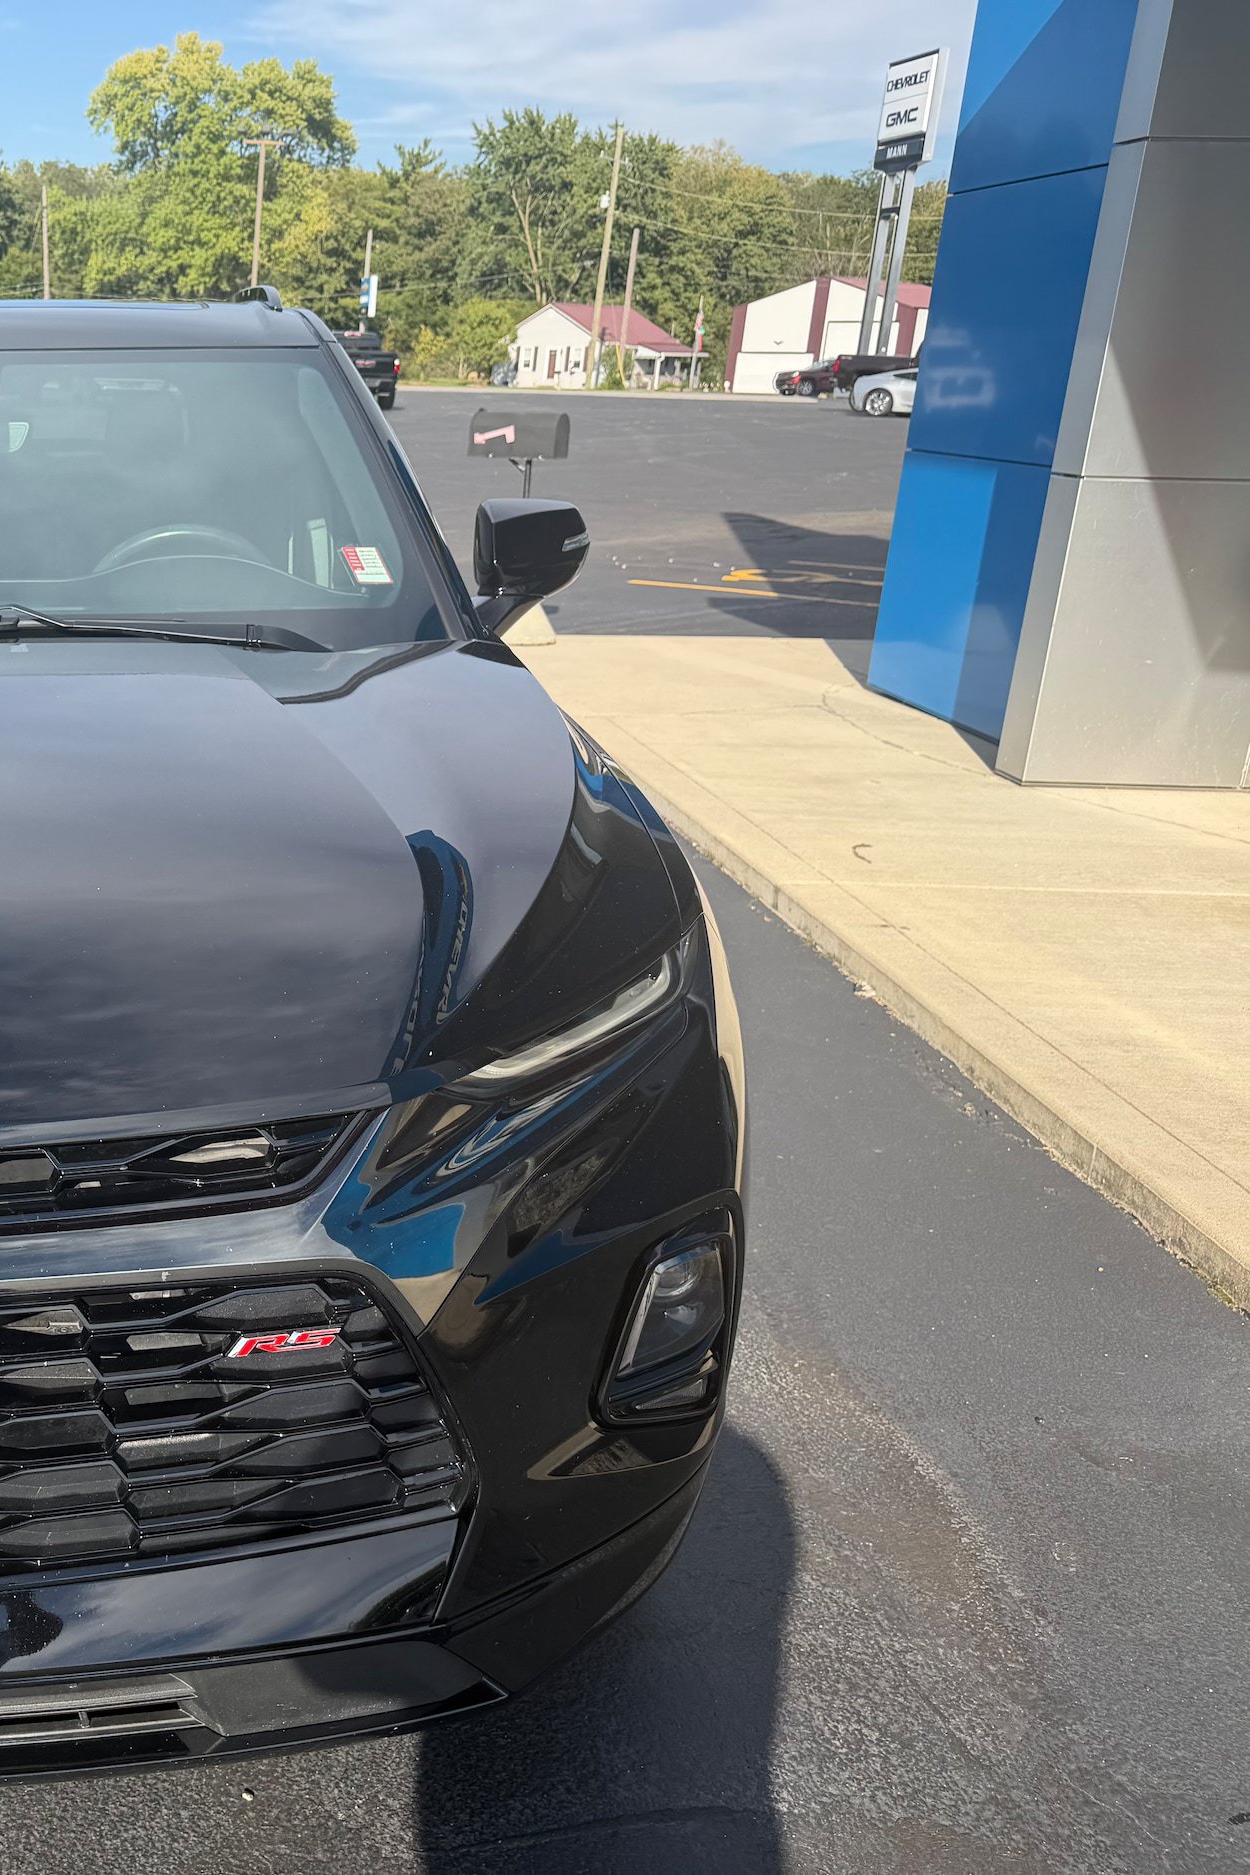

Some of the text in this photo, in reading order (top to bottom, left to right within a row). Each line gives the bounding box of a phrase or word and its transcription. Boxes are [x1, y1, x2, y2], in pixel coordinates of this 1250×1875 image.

[886, 70, 930, 92] CHEVROLET
[885, 107, 918, 127] GMC
[886, 144, 908, 159] MANN
[228, 1328, 341, 1358] RS
